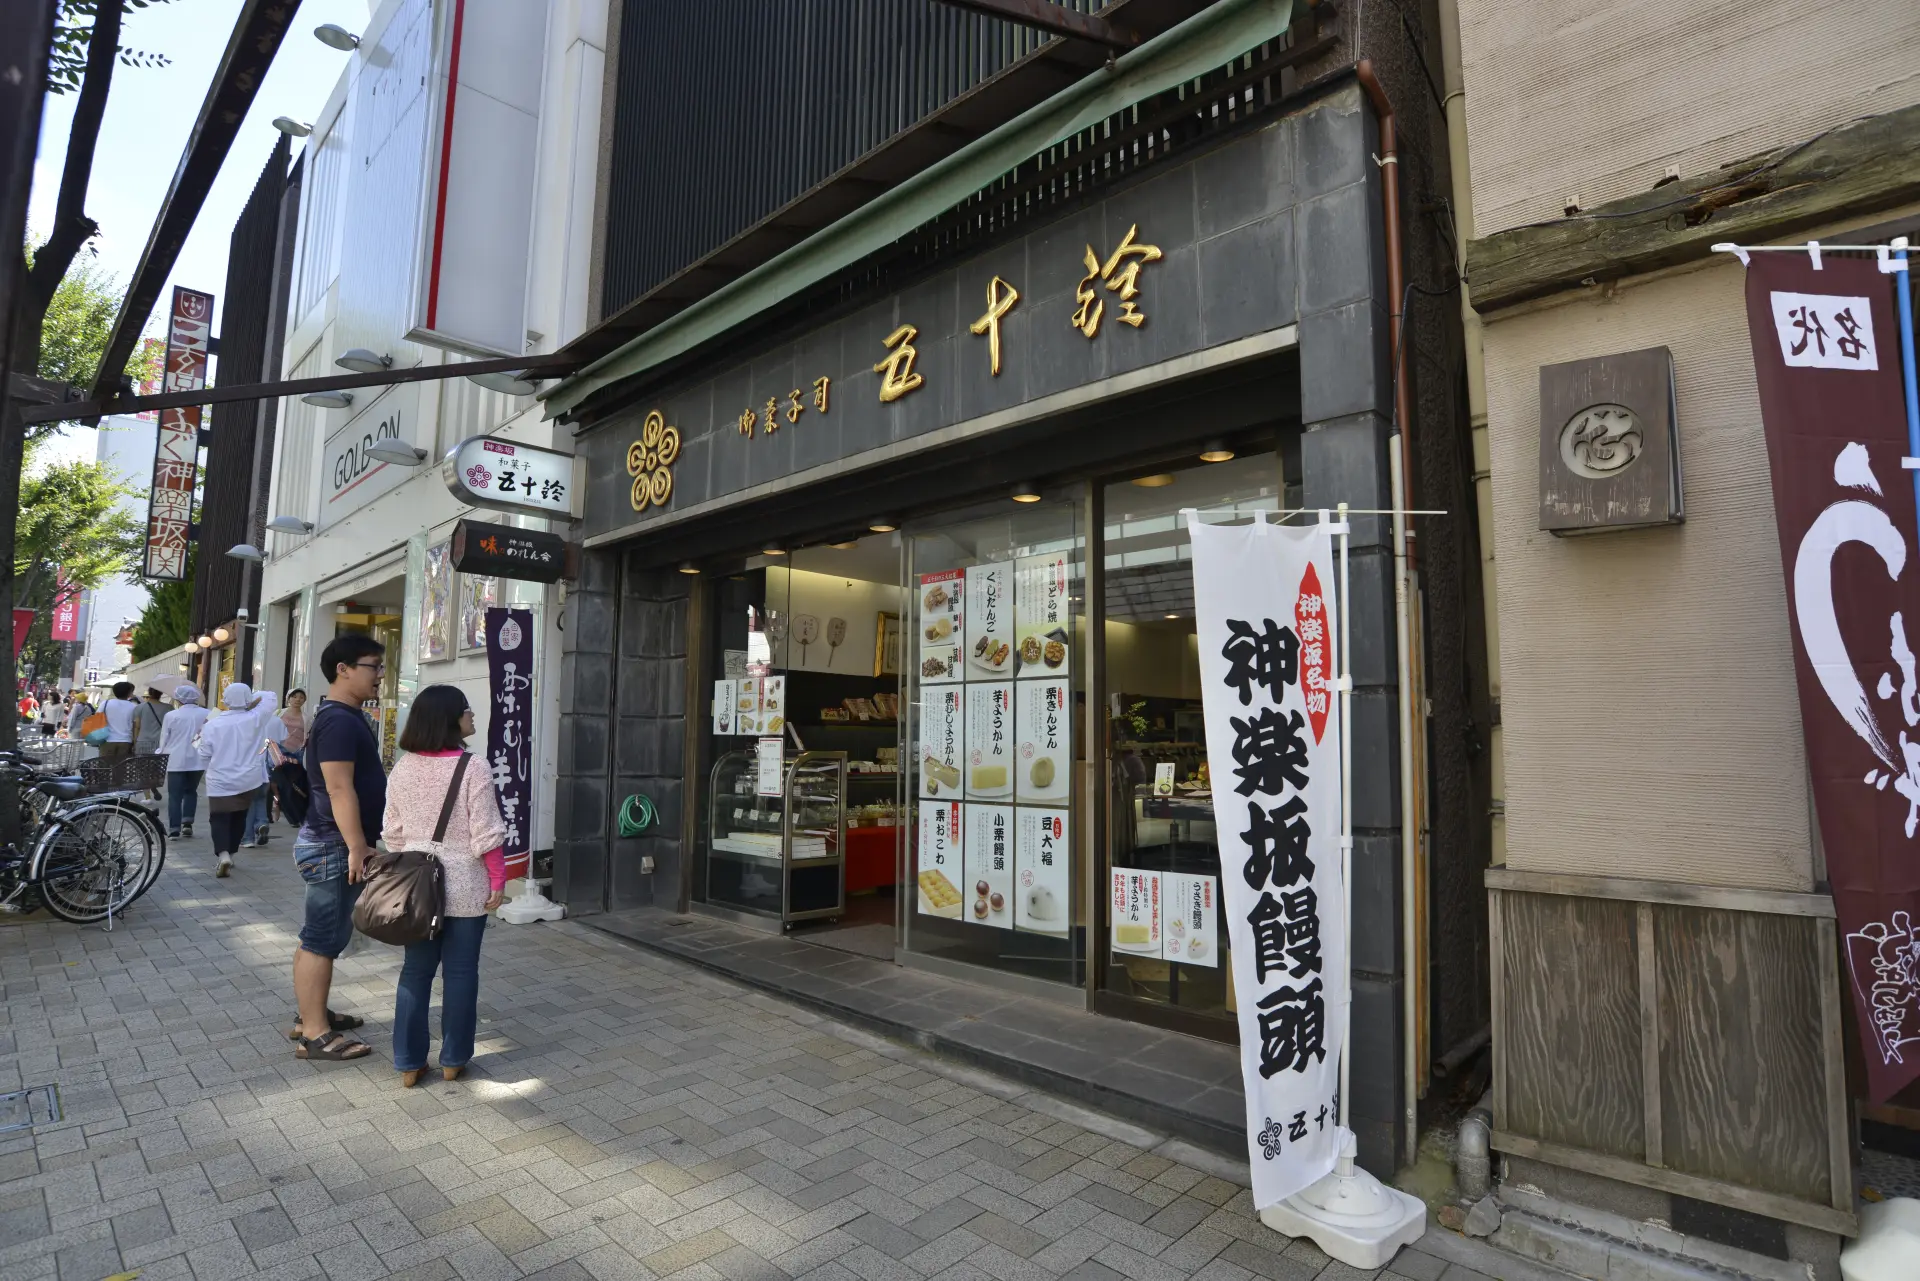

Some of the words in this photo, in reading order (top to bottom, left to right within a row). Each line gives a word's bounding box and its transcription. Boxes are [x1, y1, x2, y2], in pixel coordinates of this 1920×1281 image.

[873, 223, 1163, 402] 五十鈴
[497, 471, 566, 502] 五十鈴
[498, 456, 532, 471] 和菓子
[986, 571, 997, 633] くしだんご
[1298, 593, 1328, 715] 神楽坂名物
[992, 689, 1003, 755] 芋ようかん
[1045, 686, 1058, 749] 栗きんとん
[935, 808, 945, 865] 栗おこわ
[993, 813, 1005, 871] 小栗饅頭
[1041, 816, 1053, 866] 豆大福
[1220, 616, 1328, 1081] 神楽坂饅頭
[1130, 875, 1139, 922] 芋ようかん
